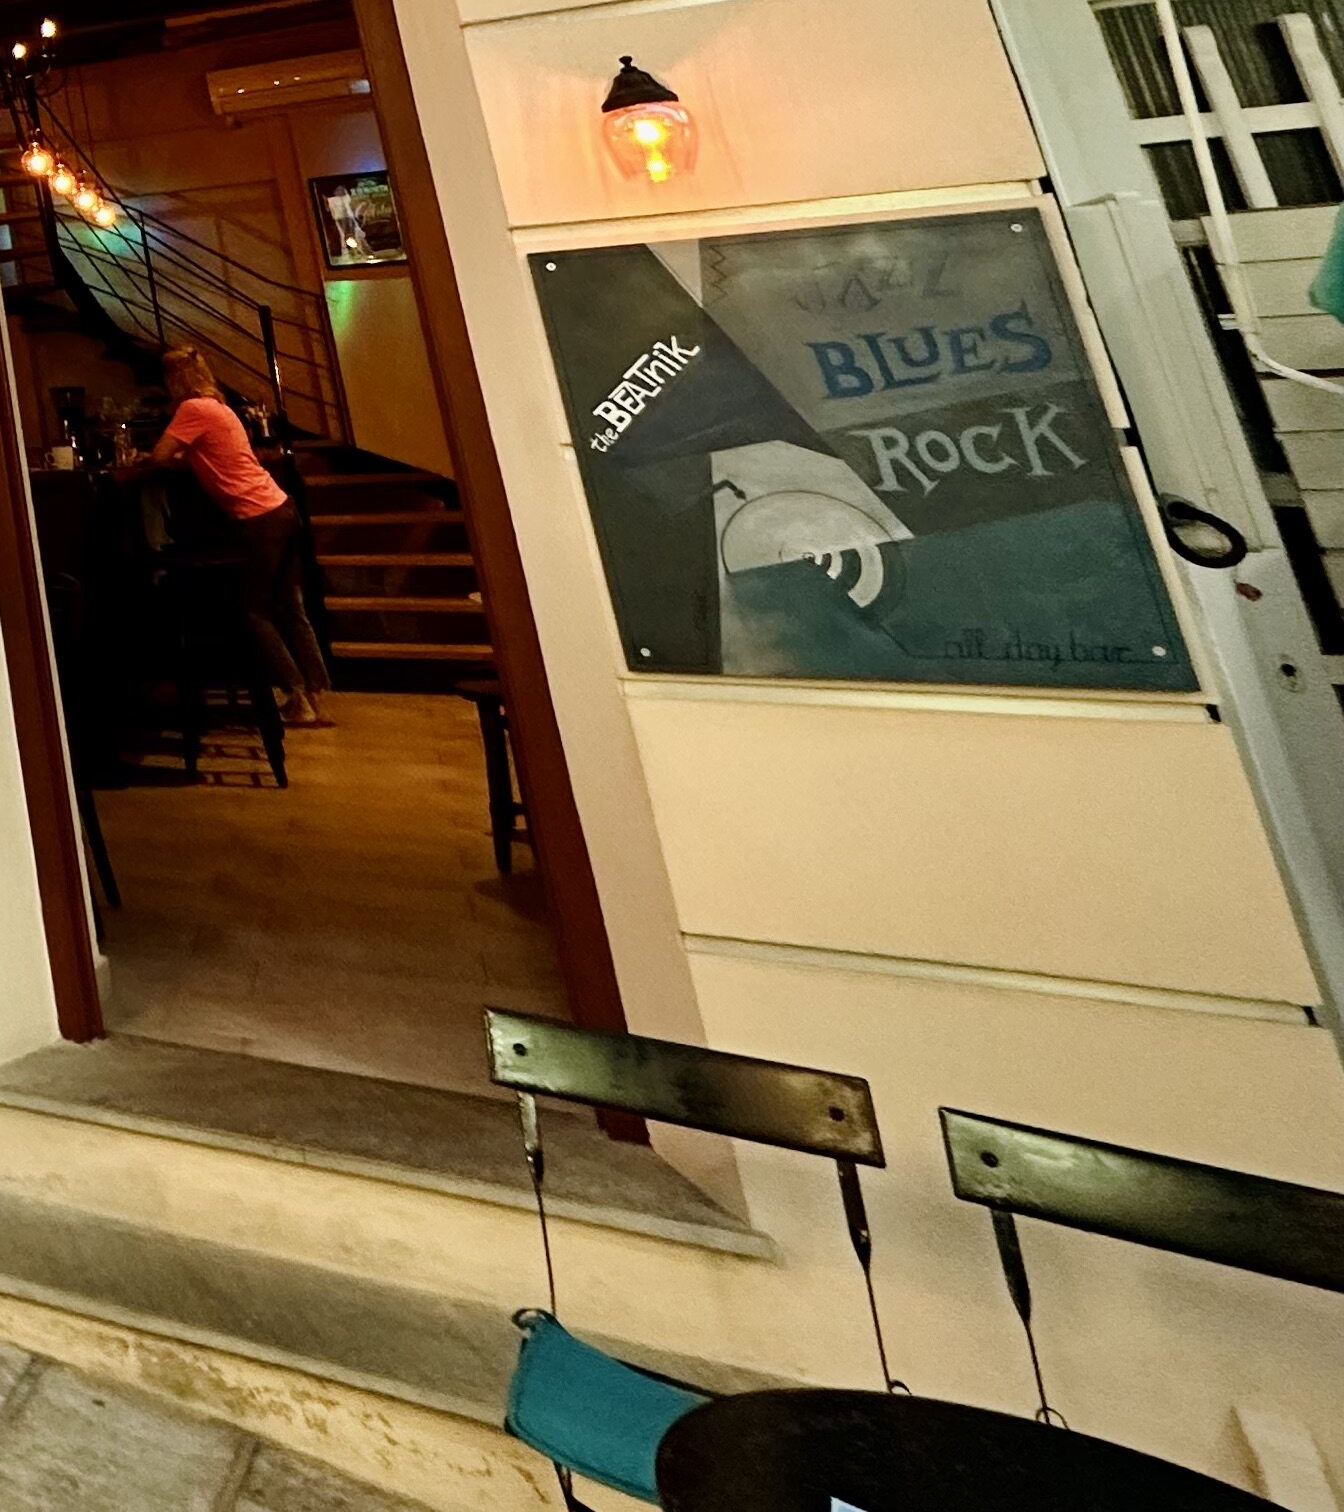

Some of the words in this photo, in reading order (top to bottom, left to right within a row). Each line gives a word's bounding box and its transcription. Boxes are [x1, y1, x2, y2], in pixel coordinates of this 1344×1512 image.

[802, 298, 1053, 400] BLUES
[590, 427, 619, 453] the
[847, 402, 1090, 498] ROCK
[1006, 629, 1063, 672] day
